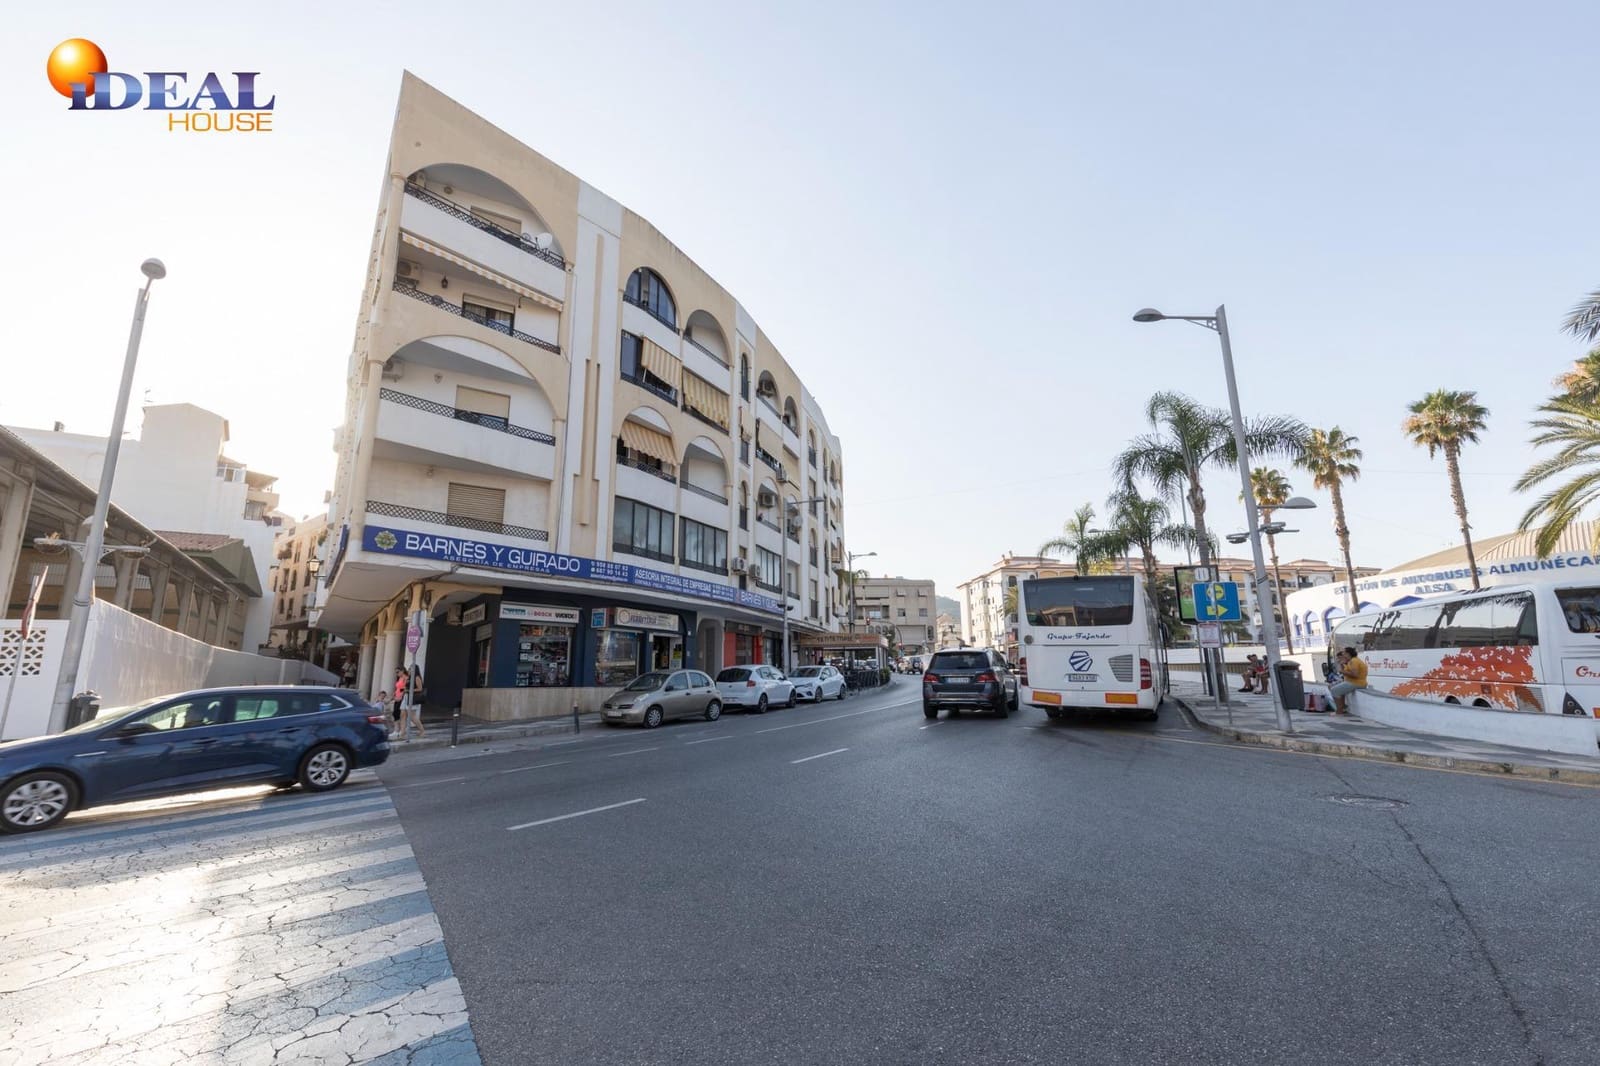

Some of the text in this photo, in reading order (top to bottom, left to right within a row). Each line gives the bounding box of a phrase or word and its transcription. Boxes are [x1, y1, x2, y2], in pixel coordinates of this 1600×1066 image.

[405, 534, 580, 572] BARNÉS Y GUIRADO
[507, 563, 551, 573] EMPRESAS
[660, 574, 682, 587] INTEGRAL
[689, 580, 712, 592] EMPRESAS
[1381, 578, 1398, 588] DE
[1415, 582, 1456, 595] ALSA
[1075, 632, 1112, 640] Fajardo
